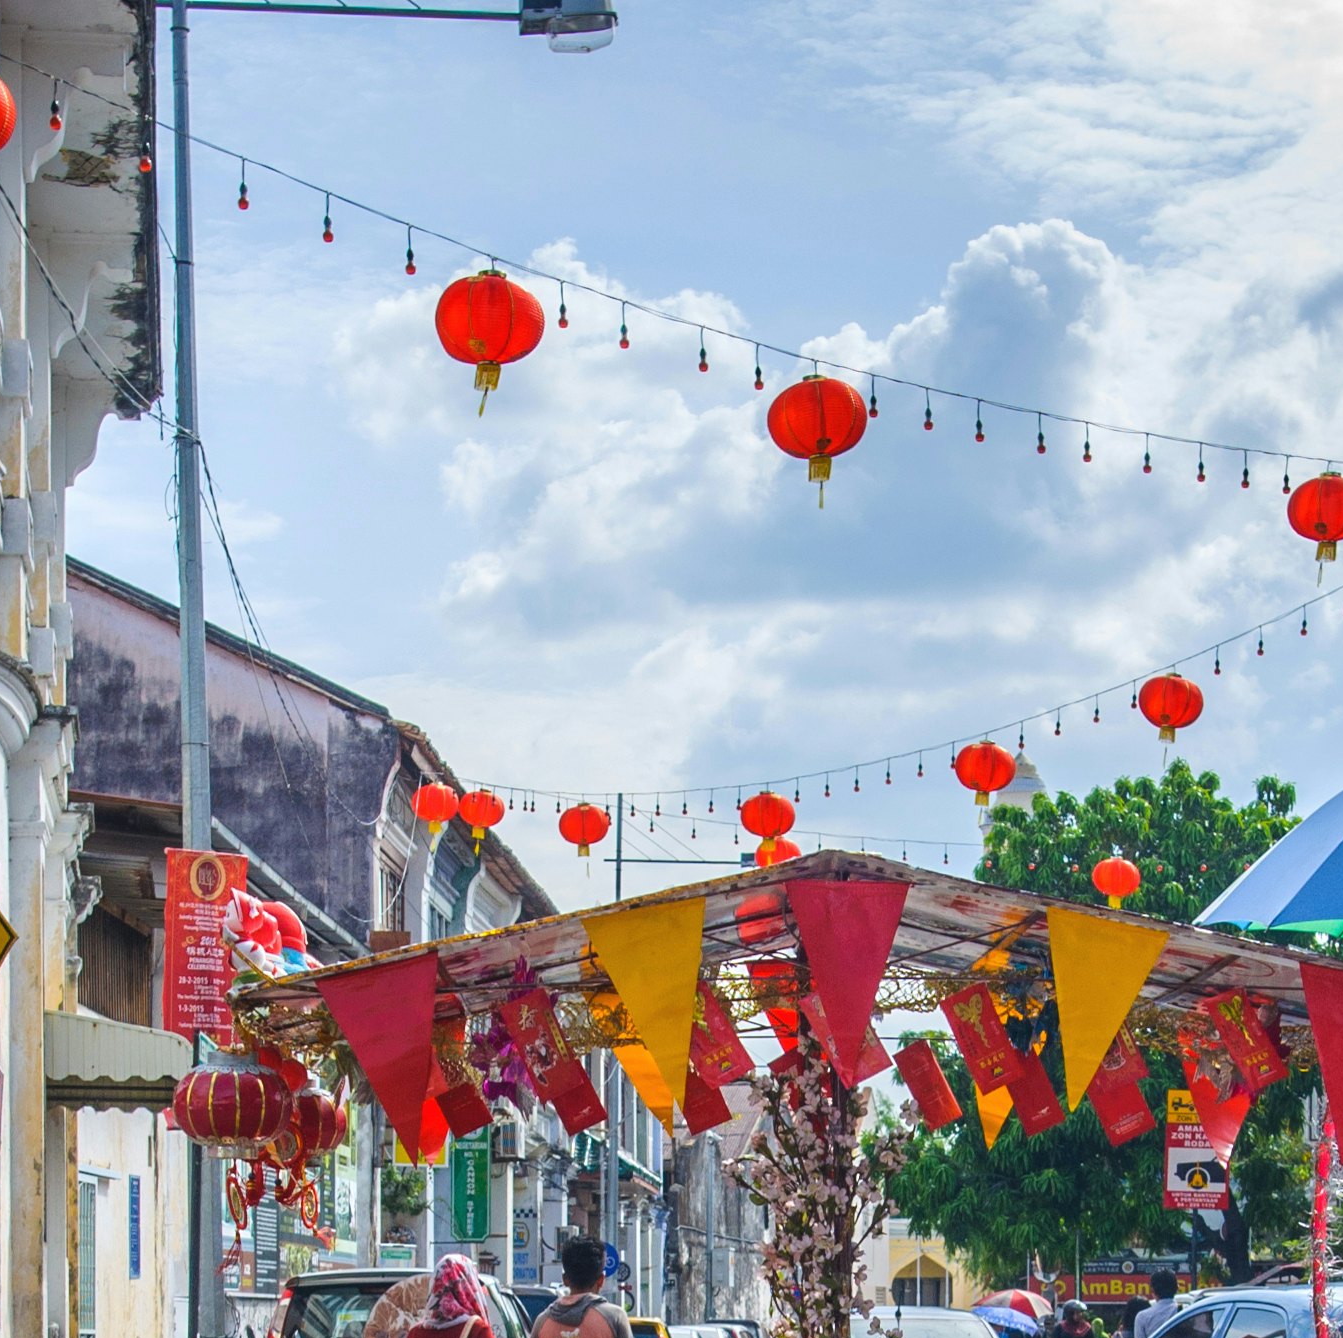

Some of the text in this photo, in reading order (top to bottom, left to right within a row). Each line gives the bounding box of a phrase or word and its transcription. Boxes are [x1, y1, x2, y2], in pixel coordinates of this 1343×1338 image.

[1171, 1132, 1192, 1140] ZON
[466, 1159, 476, 1195] CANNON
[466, 1201, 475, 1236] STREET
[1081, 1279, 1150, 1296] AmBan
